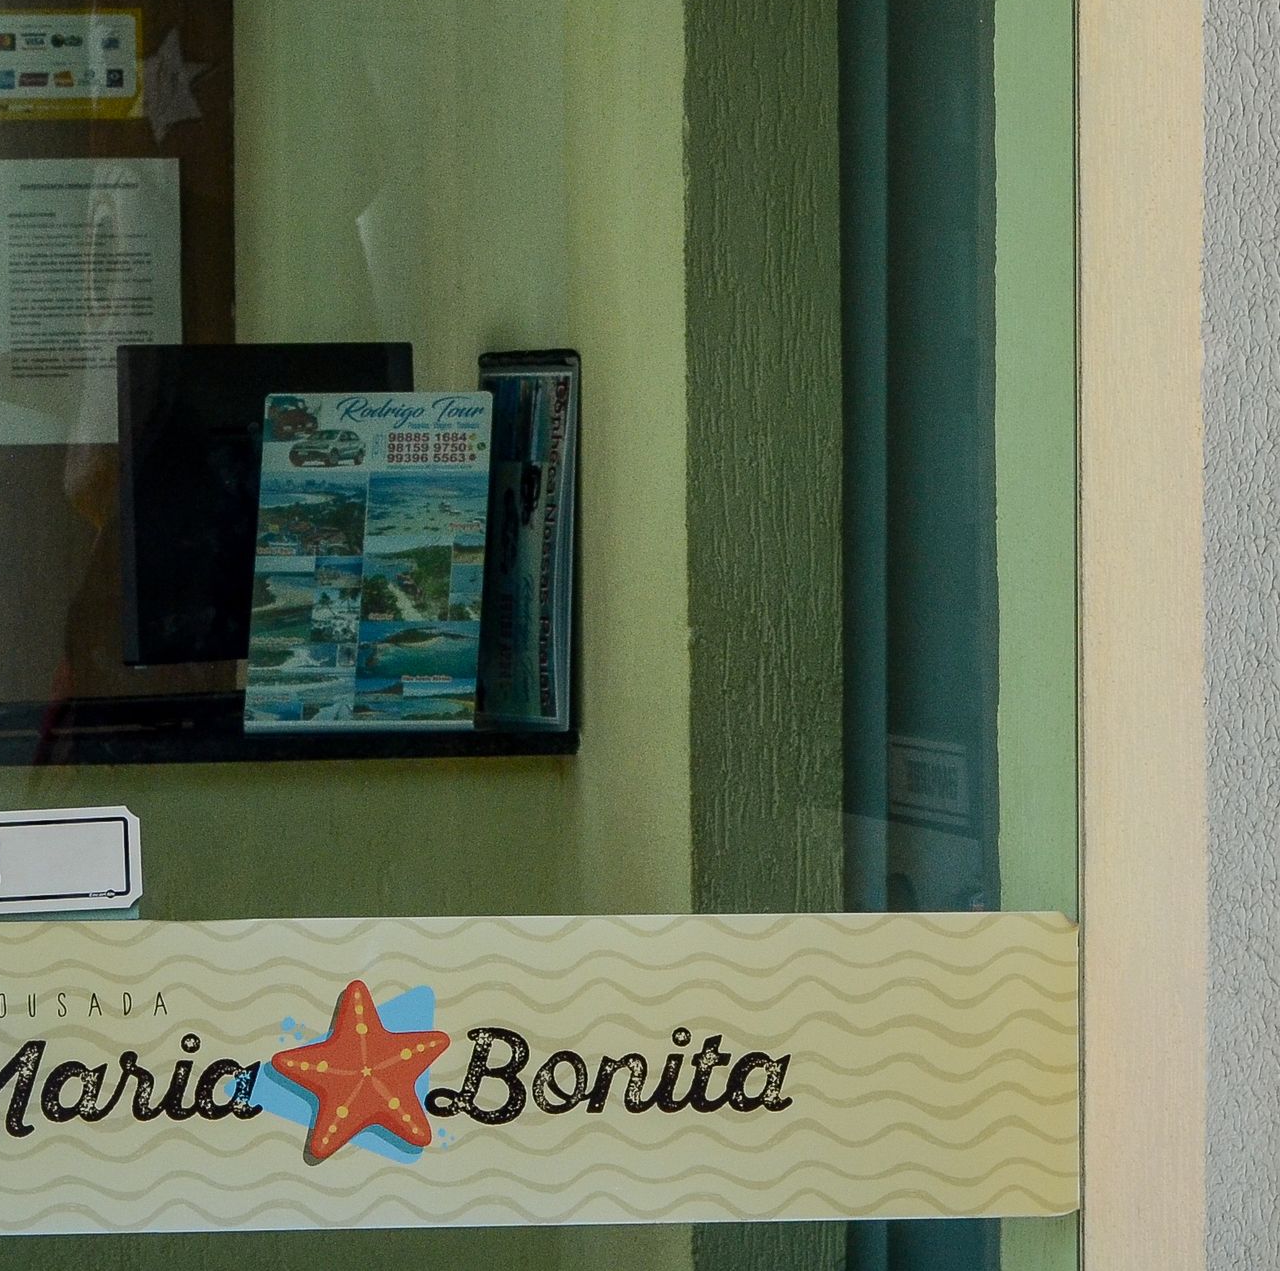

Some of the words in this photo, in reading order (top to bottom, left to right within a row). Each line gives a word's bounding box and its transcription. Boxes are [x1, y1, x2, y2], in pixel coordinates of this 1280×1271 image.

[336, 395, 425, 429] Rodrigo
[431, 395, 485, 423] Tour
[387, 432, 430, 442] 98885
[435, 432, 467, 442] 1684
[387, 443, 429, 453] 98159
[433, 443, 466, 453] 9750
[386, 453, 428, 463] 99396
[433, 453, 466, 463] 5563
[539, 502, 559, 606] Nossas
[423, 1026, 794, 1125] Bonita
